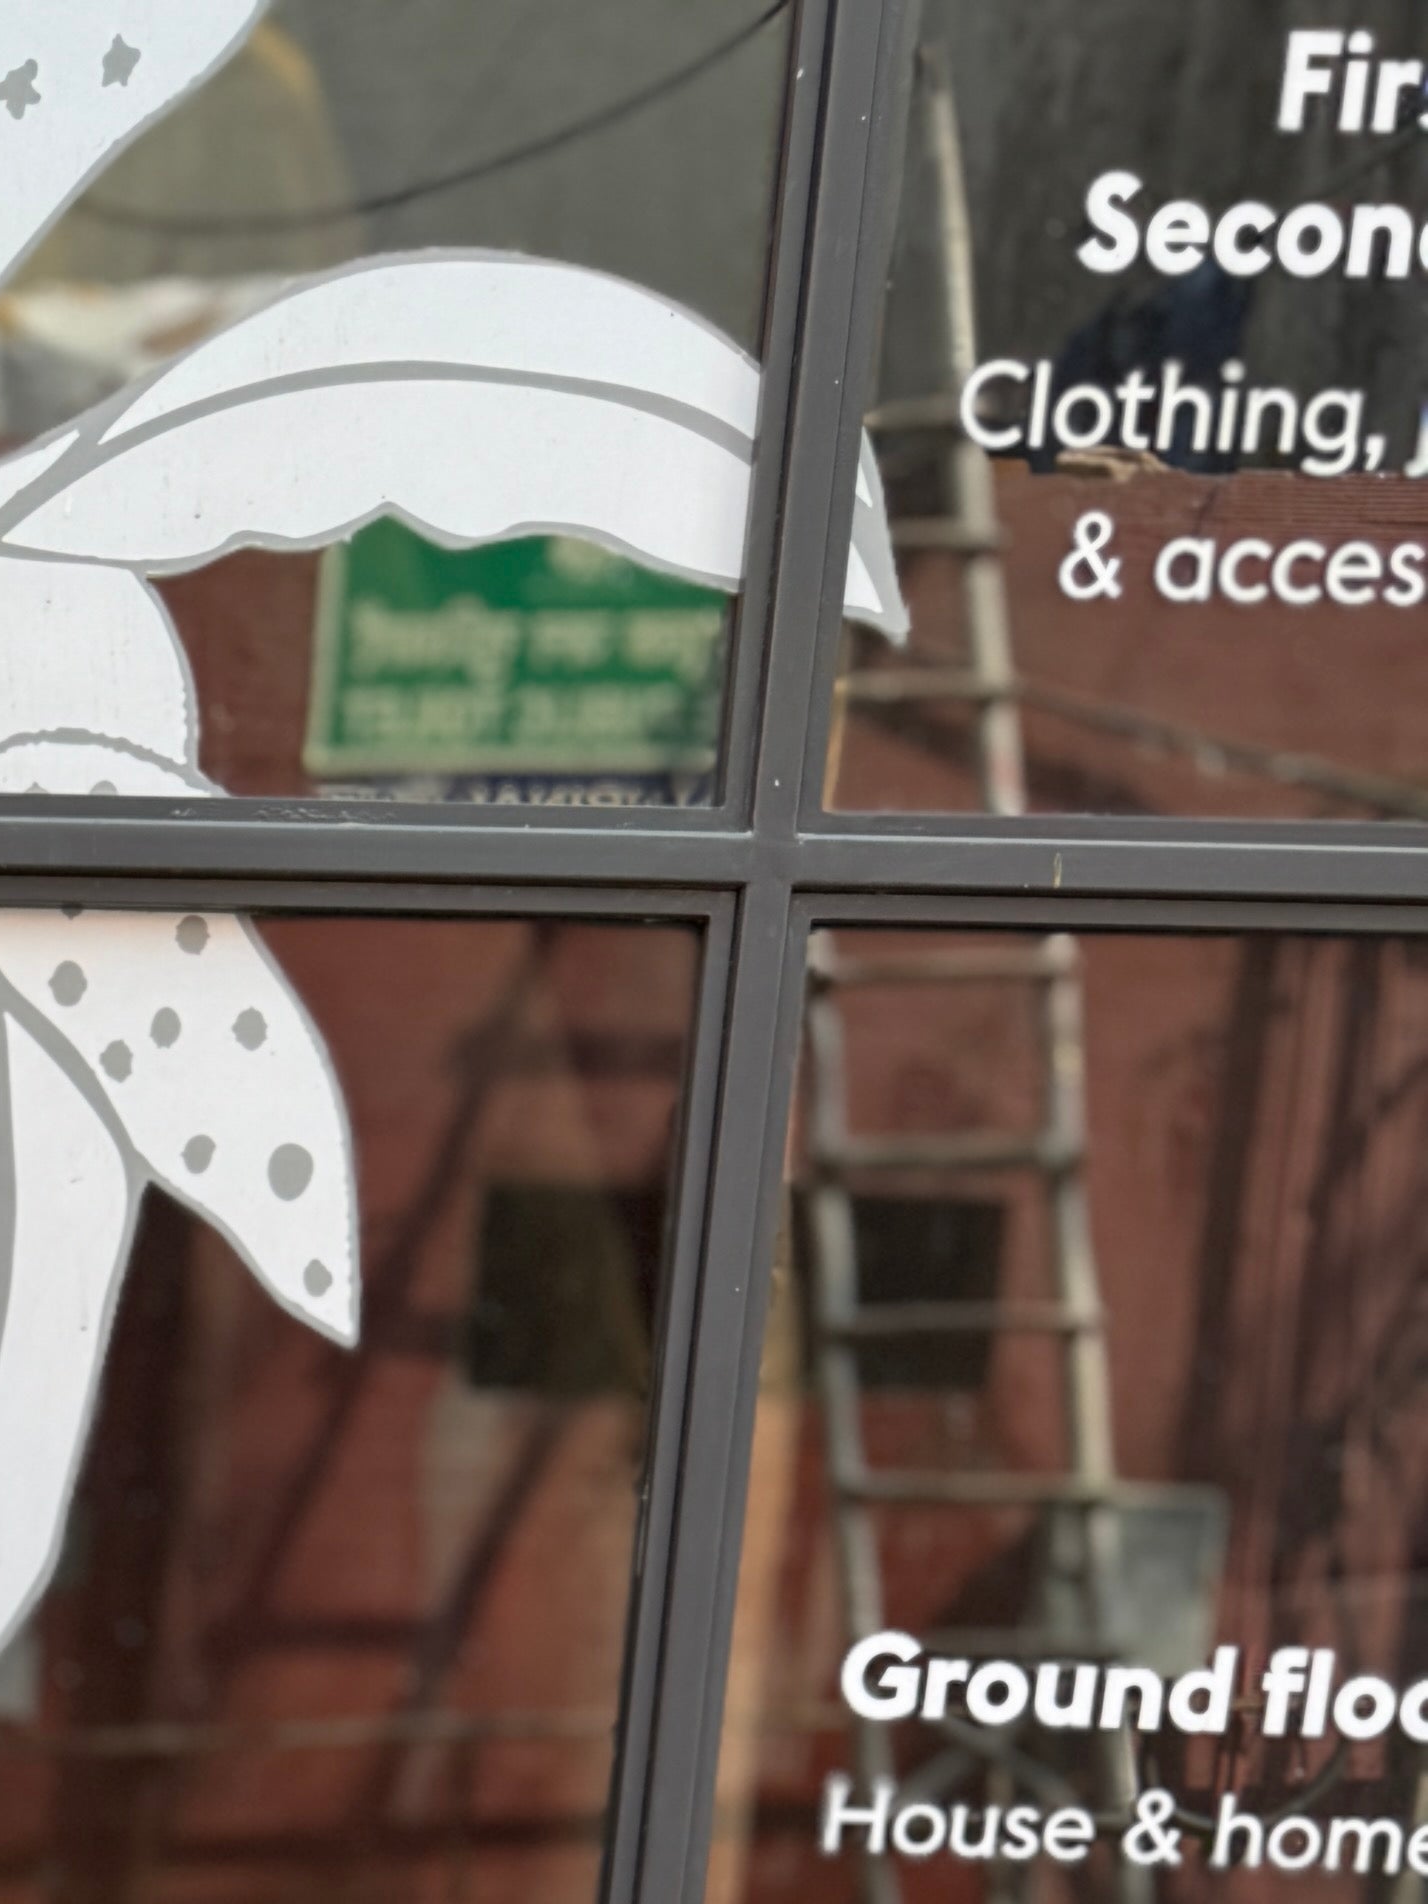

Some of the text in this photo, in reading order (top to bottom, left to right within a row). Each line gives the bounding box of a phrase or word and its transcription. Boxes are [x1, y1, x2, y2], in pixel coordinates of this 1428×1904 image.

[1276, 28, 1428, 134] Fir
[1076, 169, 1428, 279] Secon
[959, 357, 1386, 478] Clothing,
[1057, 509, 1428, 608] & acces
[840, 1630, 1238, 1735] Ground
[820, 1776, 1096, 1863] House
[1120, 1788, 1182, 1867] &
